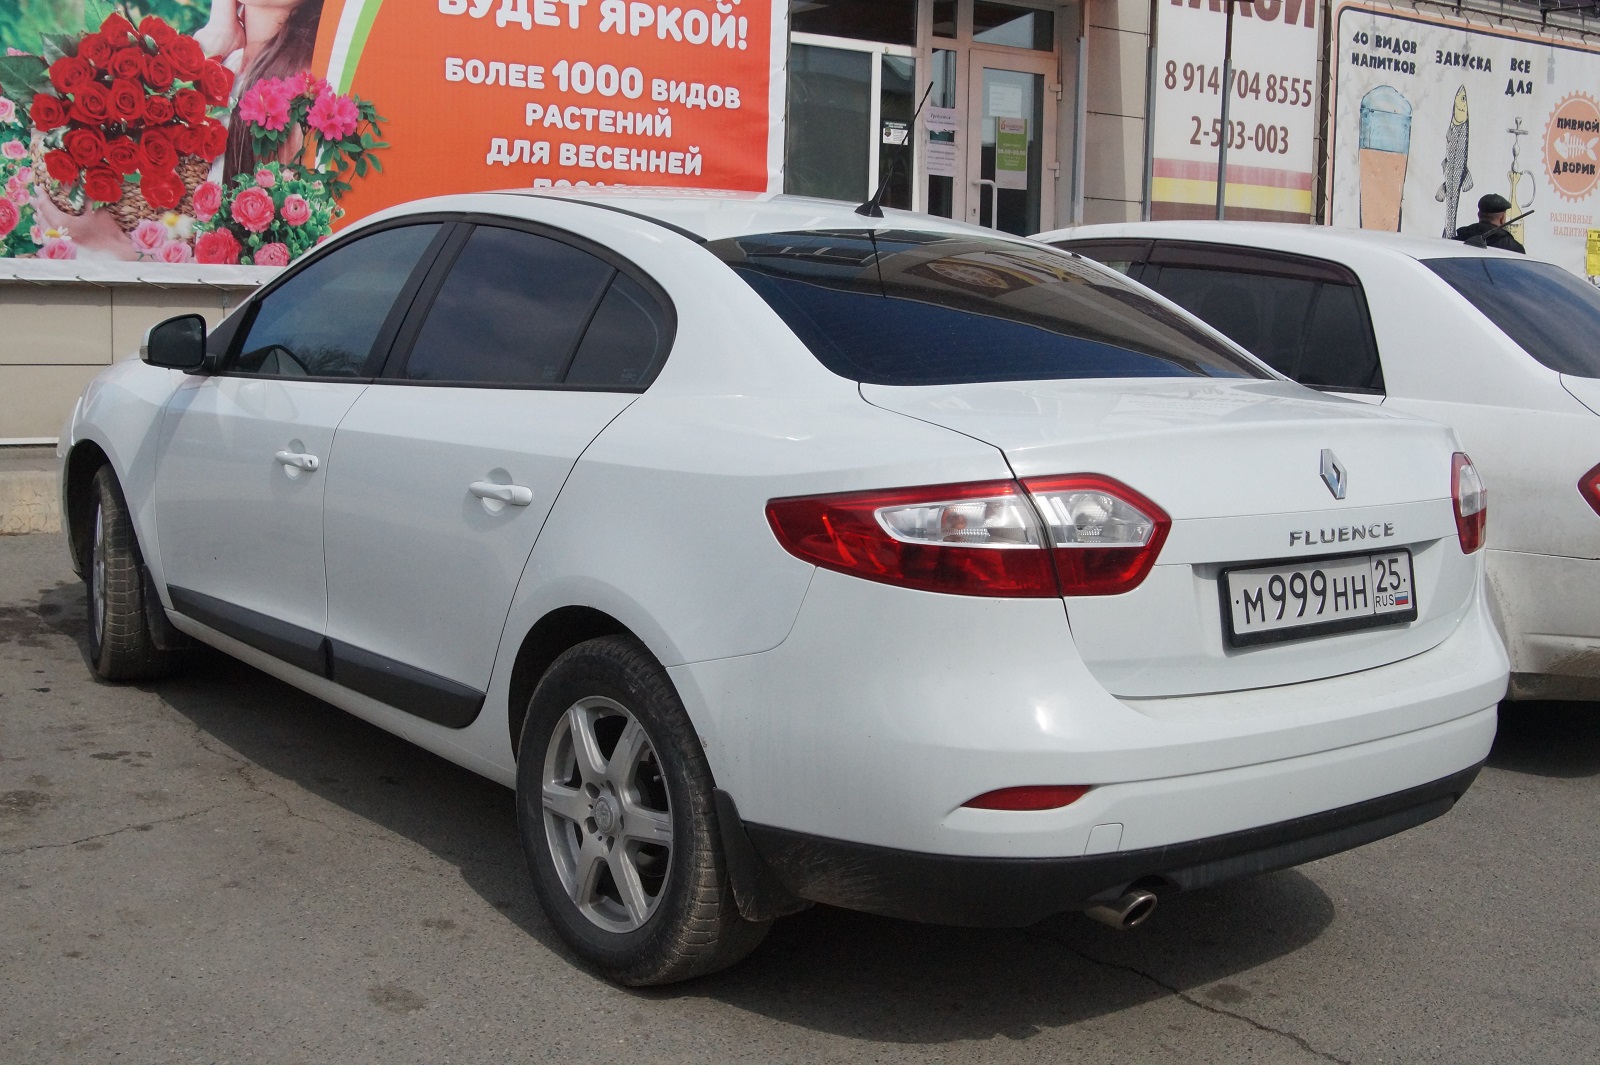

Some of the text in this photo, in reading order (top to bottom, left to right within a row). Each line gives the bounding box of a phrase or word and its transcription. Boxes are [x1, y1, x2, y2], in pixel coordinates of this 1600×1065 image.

[599, 0, 748, 50] ЯРКОЙ!
[1353, 31, 1417, 55] 40 ВИДОВ
[1351, 52, 1417, 75] НАПИТКОВ
[1435, 50, 1492, 73] ЗАКУСКА
[1510, 57, 1531, 74] ВСЕ
[445, 57, 741, 109] БОЛЕЕ 1000 ВИДОВ
[1164, 60, 1177, 90] 8
[1182, 62, 1220, 95] 914
[1266, 74, 1312, 107] 8555
[1505, 78, 1533, 96] ДЛЯ
[525, 103, 672, 138] РАСТЕНИЙ
[1557, 117, 1599, 133] ПИВНОЙ
[1190, 115, 1289, 154] 2-503-003
[486, 137, 702, 176] ДЛЯ ВЕСЕННЕЙ
[1553, 160, 1596, 175] ДВОРИК
[1550, 212, 1592, 225] РАЗЛИВНЫЕ
[1290, 522, 1395, 546] FLUENCE
[1375, 558, 1401, 592] 25
[1375, 593, 1395, 608] RUS
